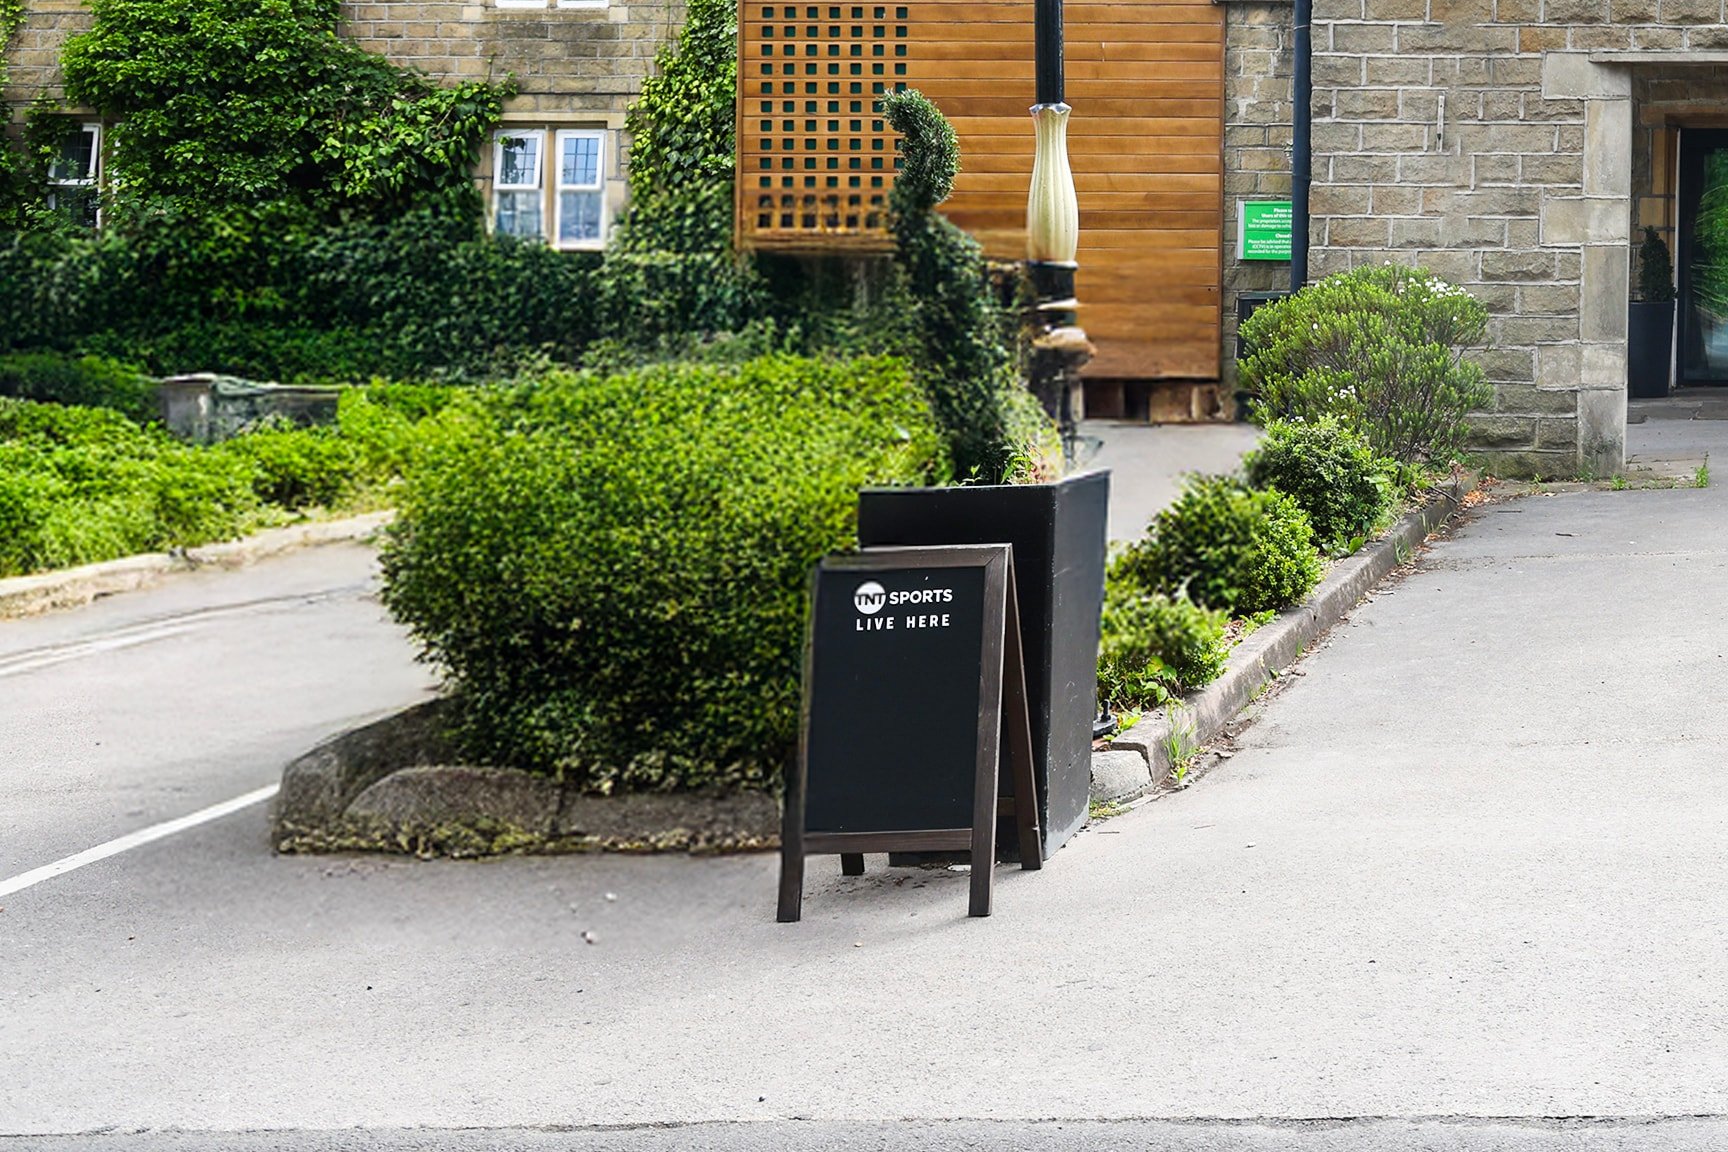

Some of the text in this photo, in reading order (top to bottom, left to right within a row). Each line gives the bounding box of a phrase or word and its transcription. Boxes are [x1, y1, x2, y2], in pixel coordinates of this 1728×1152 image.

[889, 588, 953, 605] SPORTS
[856, 614, 950, 631] LIVE HERE
